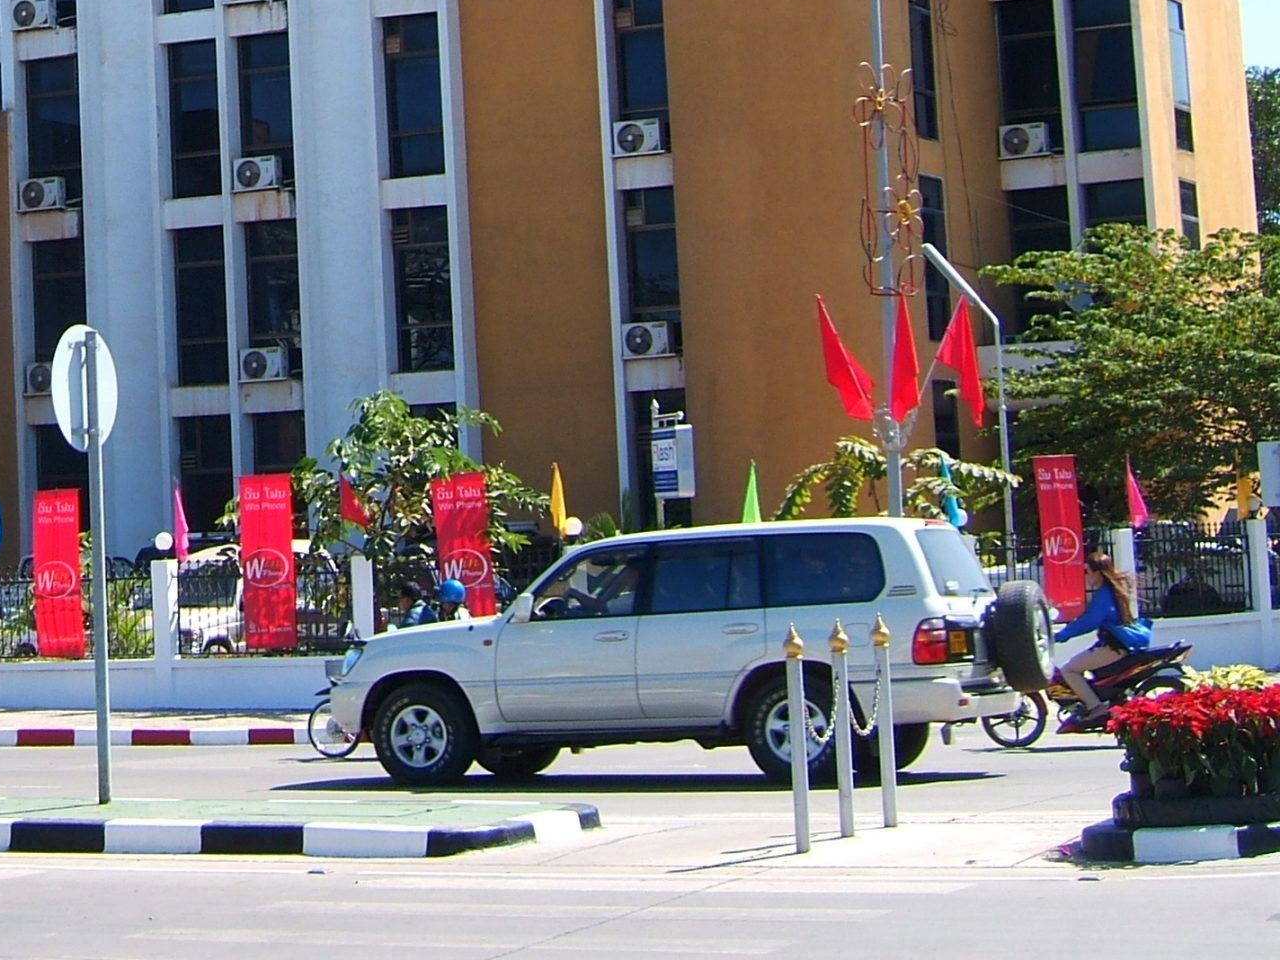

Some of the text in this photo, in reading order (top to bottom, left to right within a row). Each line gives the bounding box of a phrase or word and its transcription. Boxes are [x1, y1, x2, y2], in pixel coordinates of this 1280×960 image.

[244, 501, 286, 511] Win Phone
[437, 500, 482, 511] Win Phone
[246, 557, 280, 579] Win
[444, 557, 479, 580] Win
[297, 623, 338, 637] SUZ
